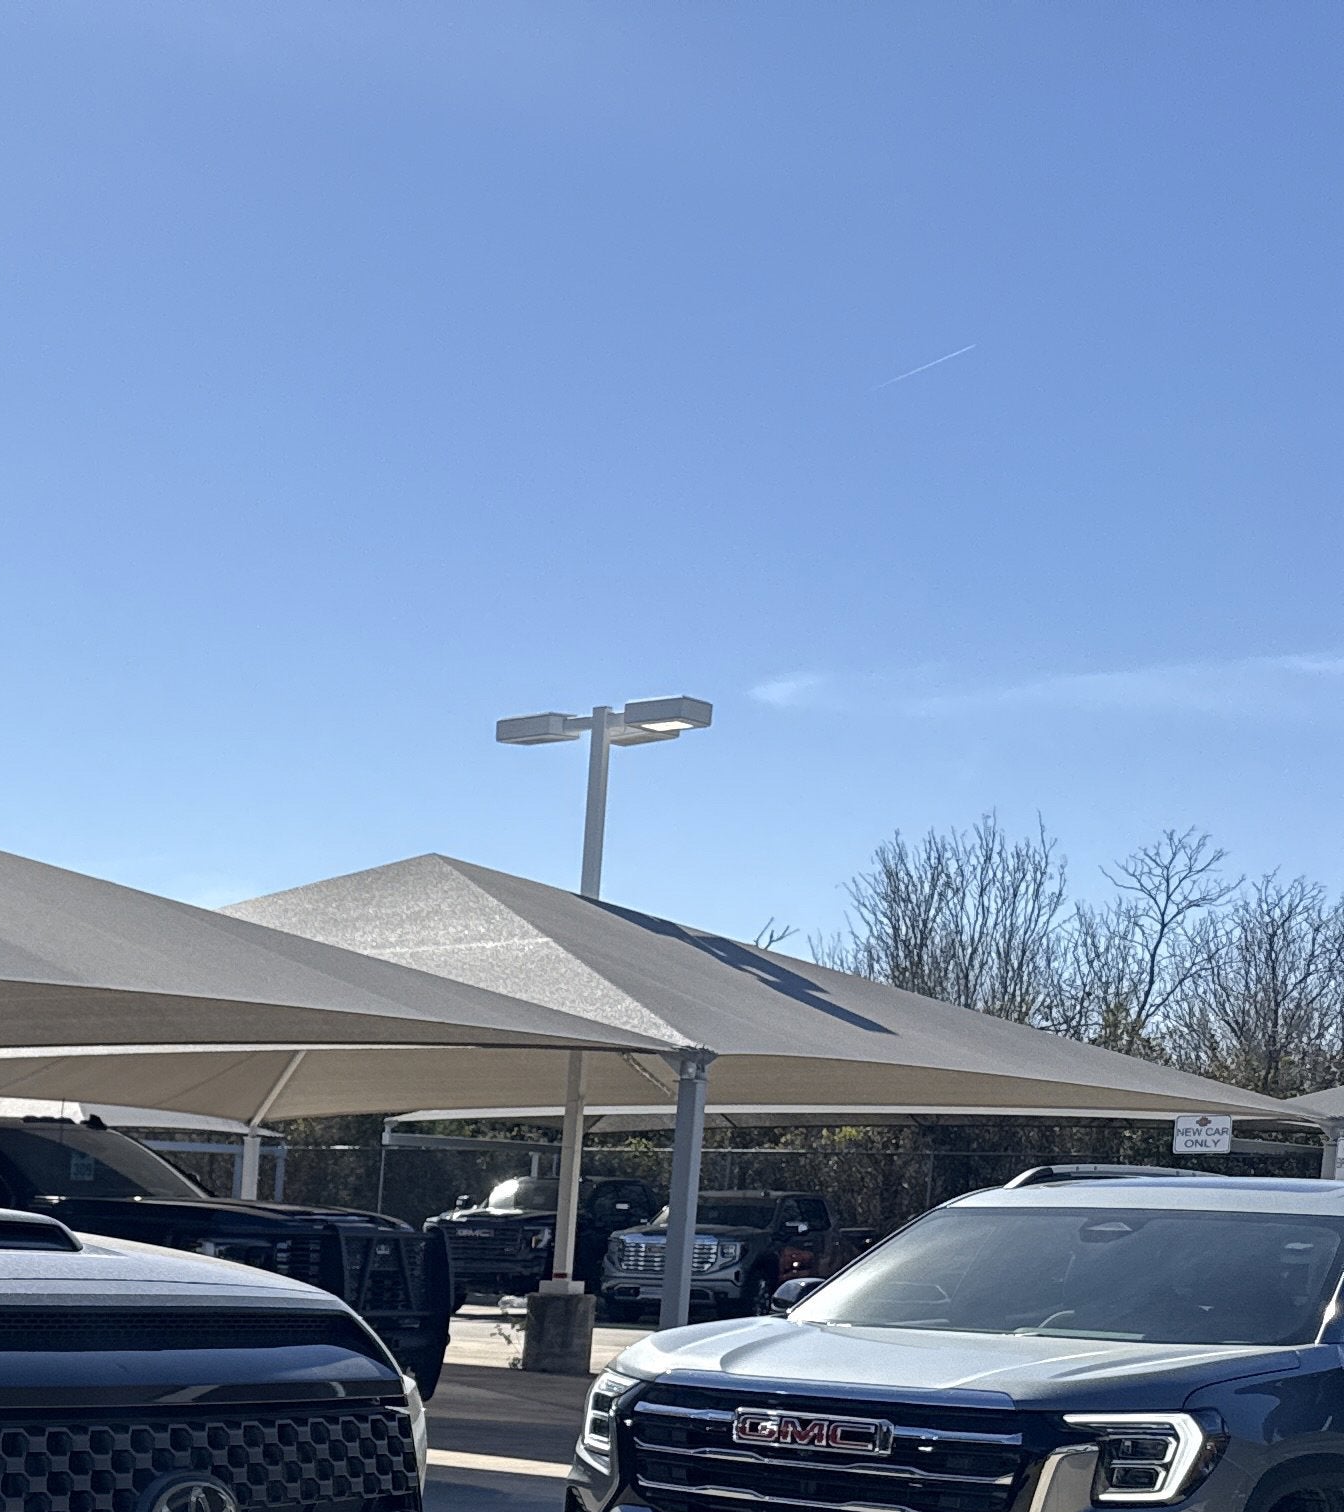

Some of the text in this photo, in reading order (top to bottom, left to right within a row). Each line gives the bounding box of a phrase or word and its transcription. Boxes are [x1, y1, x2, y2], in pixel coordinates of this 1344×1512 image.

[1176, 1127, 1229, 1137] NEW CAR
[1184, 1139, 1220, 1148] ONLY
[456, 1228, 494, 1238] GMC
[738, 1413, 876, 1451] GMC
